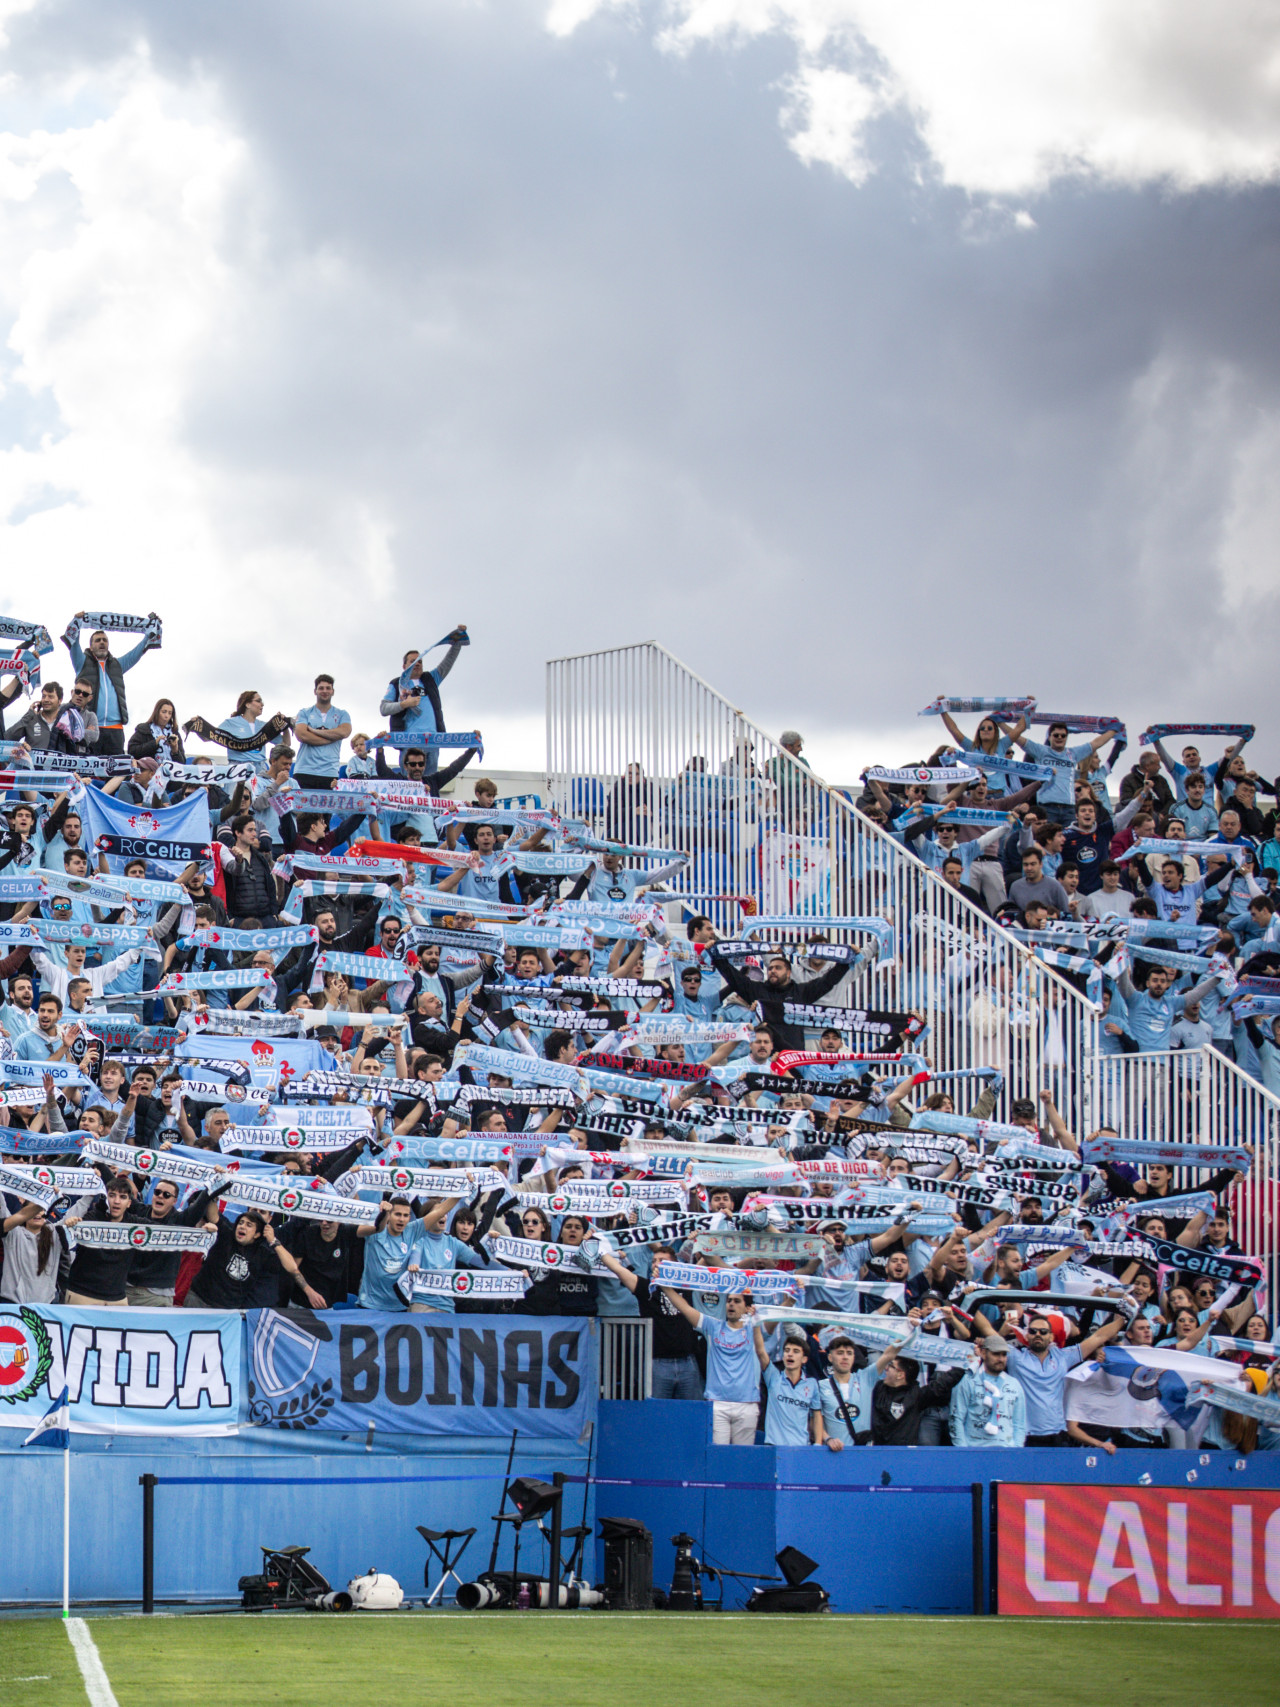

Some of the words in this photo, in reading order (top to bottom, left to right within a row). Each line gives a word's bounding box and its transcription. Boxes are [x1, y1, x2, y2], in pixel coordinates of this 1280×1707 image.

[209, 730, 227, 745] REAL
[228, 739, 247, 751] CLUB
[246, 730, 268, 750] CELTA
[394, 732, 420, 744] R.C.
[435, 732, 474, 744] CELTA
[983, 755, 1009, 767] CELTA
[1015, 761, 1038, 772] VIGO
[309, 795, 355, 809] CELTA
[417, 796, 429, 806] DE
[466, 808, 499, 817] realclub
[518, 811, 545, 820] devigo
[957, 808, 997, 820] CELTA
[320, 856, 348, 865] CELTA
[355, 858, 379, 867] VIGO
[2, 878, 34, 892] CELTA
[89, 886, 112, 899] celta
[487, 903, 518, 913] devigo
[20, 927, 31, 938] 23
[45, 925, 79, 938] IAGO
[93, 927, 140, 941] ASPAS
[561, 934, 578, 945] 23
[719, 942, 770, 955] CELTA
[805, 944, 851, 958] VIGO
[334, 954, 395, 970] AFOUTEZA
[350, 964, 398, 981] CORAZÓN
[784, 1003, 868, 1022] REALCLUB
[784, 1014, 891, 1035] CELTADEVIGO
[467, 1047, 501, 1067] REAL
[503, 1054, 538, 1075] CLUB
[540, 1064, 580, 1083] CELTA
[783, 1051, 823, 1067] CONTRA
[825, 1052, 853, 1061] VENTO
[864, 1053, 899, 1061] MAREA
[4, 1064, 34, 1076] CELTA
[41, 1067, 68, 1078] VIGO
[602, 1078, 644, 1096] Celta
[297, 1109, 314, 1126] RC
[317, 1109, 352, 1127] CELTA
[702, 1104, 792, 1124] BOINAS
[841, 1120, 867, 1133] CELTA
[26, 1135, 72, 1149] CELTA
[223, 1127, 282, 1146] MOVIDA
[305, 1128, 372, 1146] CELESTE
[468, 1132, 490, 1140] PEÑA
[491, 1132, 531, 1141] MURADANA
[532, 1133, 558, 1141] CELTISTA
[84, 1142, 134, 1164] MOVIDA
[156, 1159, 220, 1182] CELESTE
[1159, 1150, 1183, 1158] celta
[1198, 1151, 1218, 1161] vigo
[698, 1168, 734, 1178] realclub
[754, 1170, 784, 1180] devigo
[820, 1161, 840, 1173] DE
[843, 1161, 869, 1174] VIGO
[338, 1168, 391, 1193] MOVIDA
[414, 1171, 471, 1192] CELESTE
[908, 1175, 997, 1204] BOINAS
[986, 1175, 1078, 1204] BOINAS
[303, 1194, 375, 1220] CELESTE
[571, 1196, 631, 1214] CELESTE
[788, 1204, 897, 1219] BOINAS
[74, 1226, 129, 1243] MOVIDA
[149, 1226, 215, 1246] CELESTE
[615, 1217, 712, 1246] BOINAS
[722, 1236, 800, 1252] CELTA
[663, 1267, 709, 1283] CELTA
[710, 1271, 749, 1286] CLUB
[750, 1273, 790, 1287] REAL
[339, 1323, 583, 1411] BOINAS
[776, 1395, 813, 1406] CITROËN
[1025, 1498, 1280, 1607] LALI
